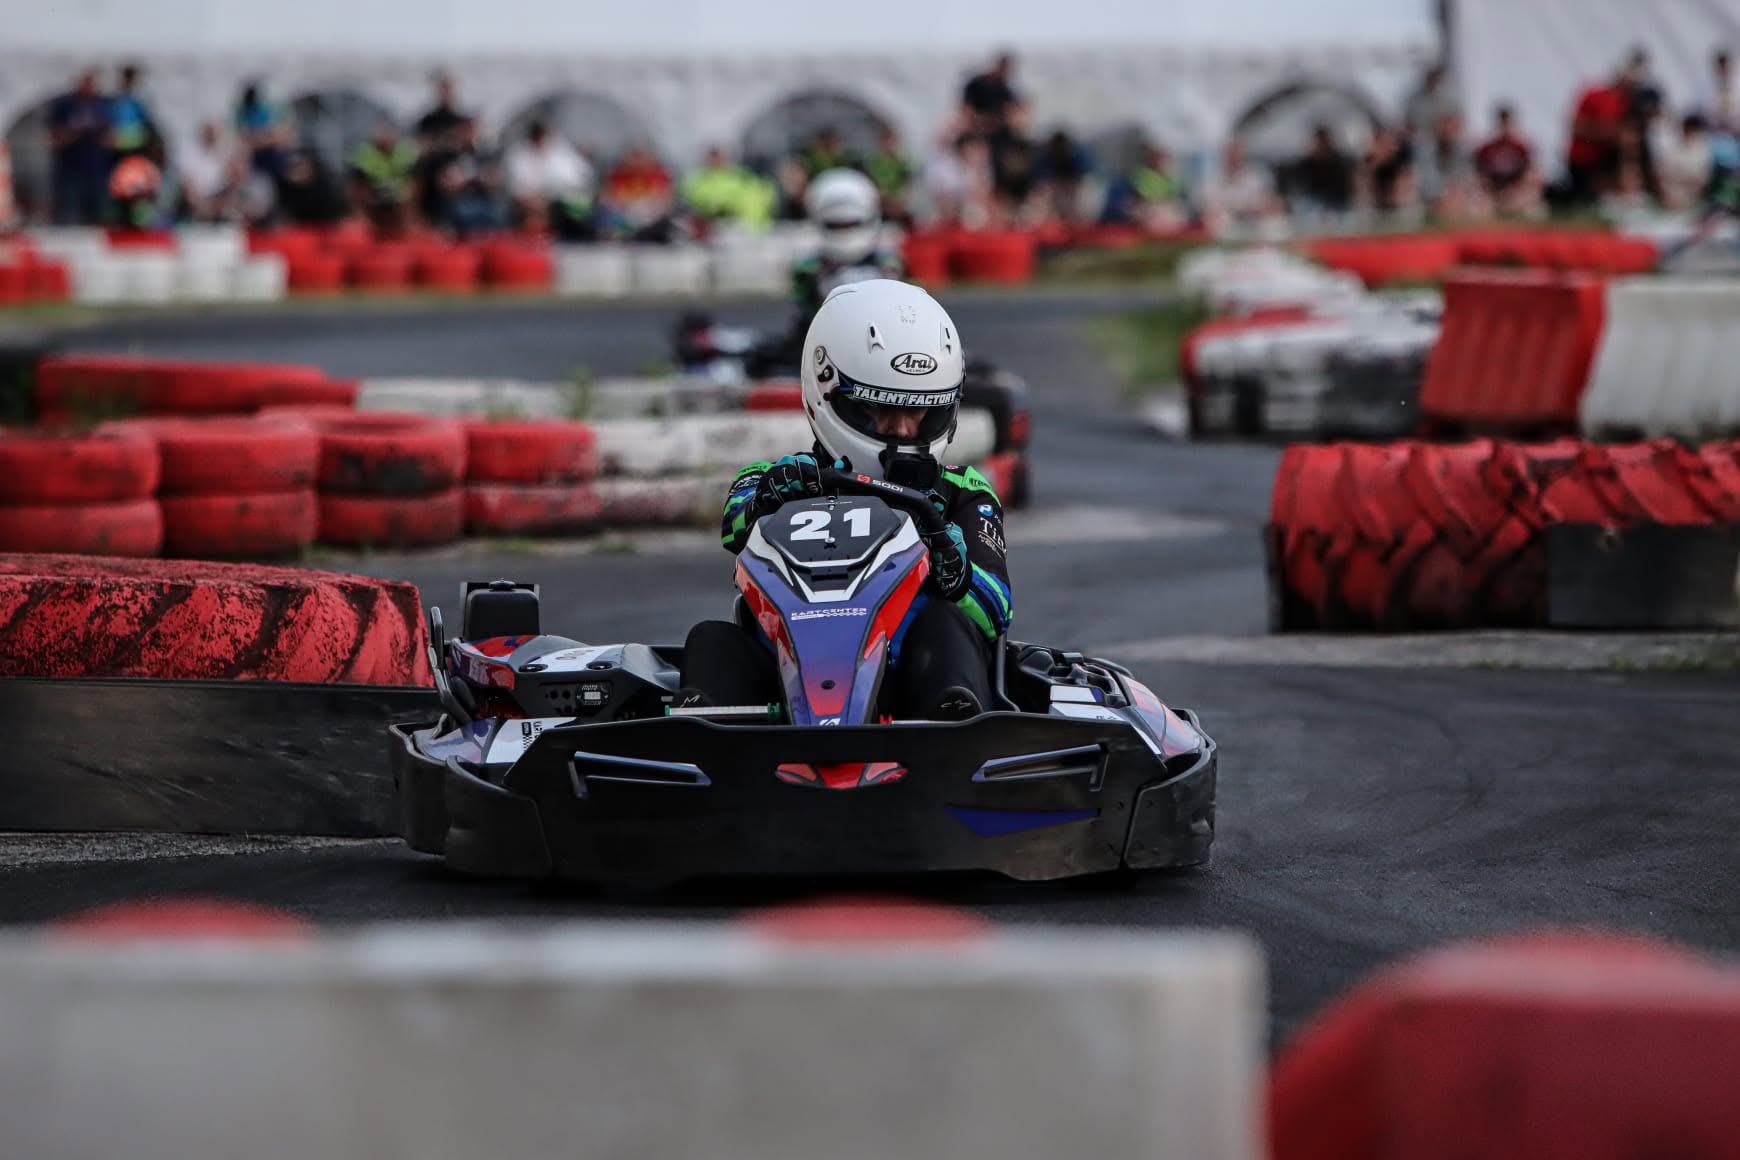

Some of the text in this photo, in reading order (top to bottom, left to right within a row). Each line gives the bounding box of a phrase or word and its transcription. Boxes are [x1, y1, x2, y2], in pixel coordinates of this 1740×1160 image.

[895, 354, 932, 369] Arai
[855, 386, 957, 405] TALENT FACTORY
[872, 479, 904, 492] SODI
[790, 507, 871, 541] 21
[791, 608, 867, 617] KARTCENTER
